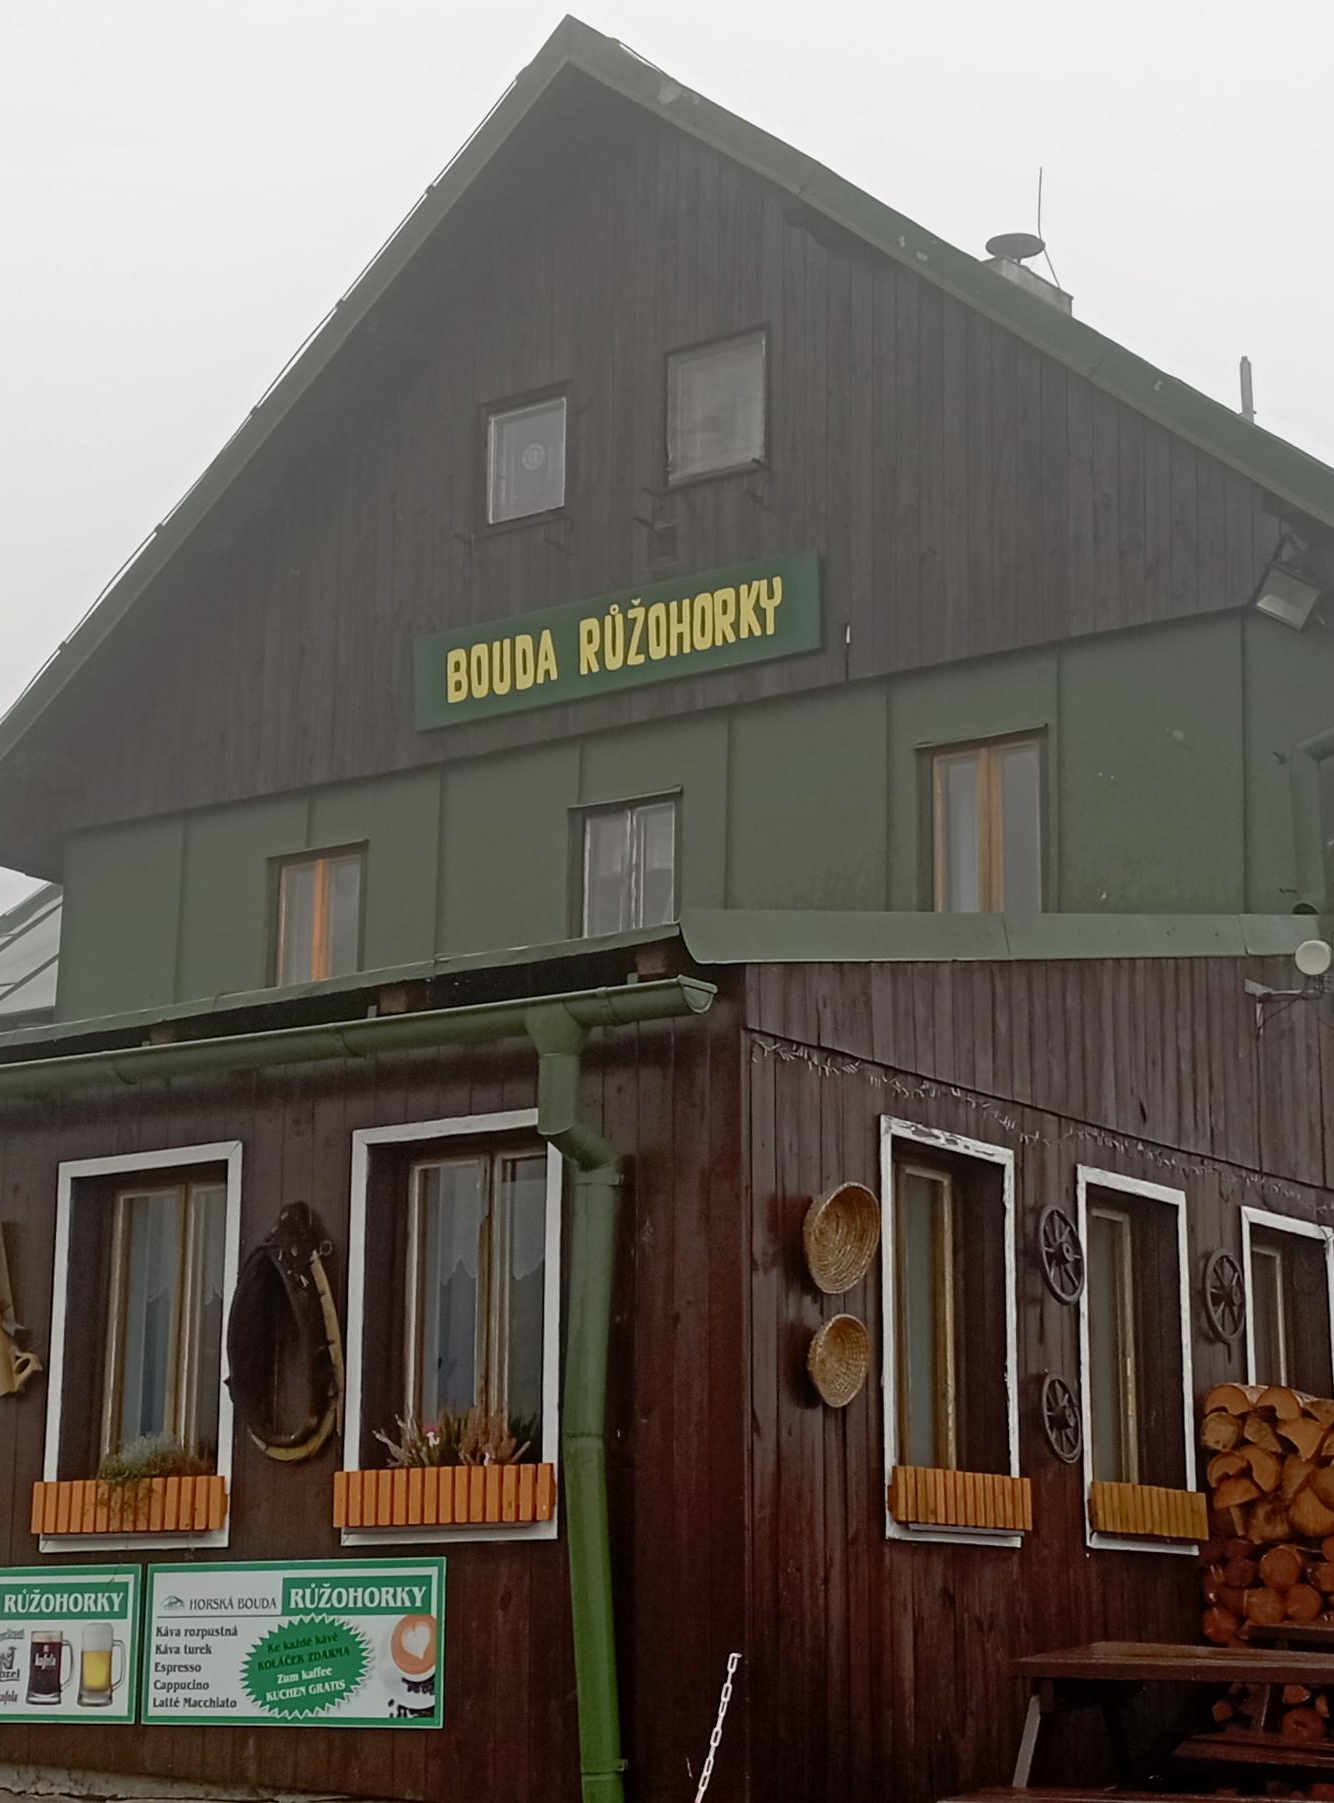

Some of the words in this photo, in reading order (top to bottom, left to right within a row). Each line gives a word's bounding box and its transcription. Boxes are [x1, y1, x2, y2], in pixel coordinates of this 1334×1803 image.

[446, 629, 558, 704] BOUDA
[579, 575, 783, 676] RŮŽOHORKY
[4, 1589, 125, 1614] RŮŽOHORKY
[189, 1595, 233, 1611] HORSKÁ
[237, 1597, 277, 1610] BOUDA
[289, 1582, 427, 1609] RŮŽOHORKY
[155, 1626, 180, 1638] Káva
[184, 1625, 238, 1639] rozpustná
[155, 1643, 180, 1656] Káva
[184, 1644, 212, 1656] turek
[267, 1643, 280, 1653] Ke
[257, 1653, 304, 1671] KOLÁČEK
[307, 1646, 350, 1662] ZDARMA
[154, 1662, 202, 1675] Espresso
[277, 1673, 299, 1684] Zum
[301, 1667, 333, 1680] kaffee
[153, 1679, 210, 1693] Cappucino
[266, 1685, 307, 1702] KUCHEN
[308, 1679, 346, 1694] GRATIS
[183, 1696, 237, 1709] Macchiato
